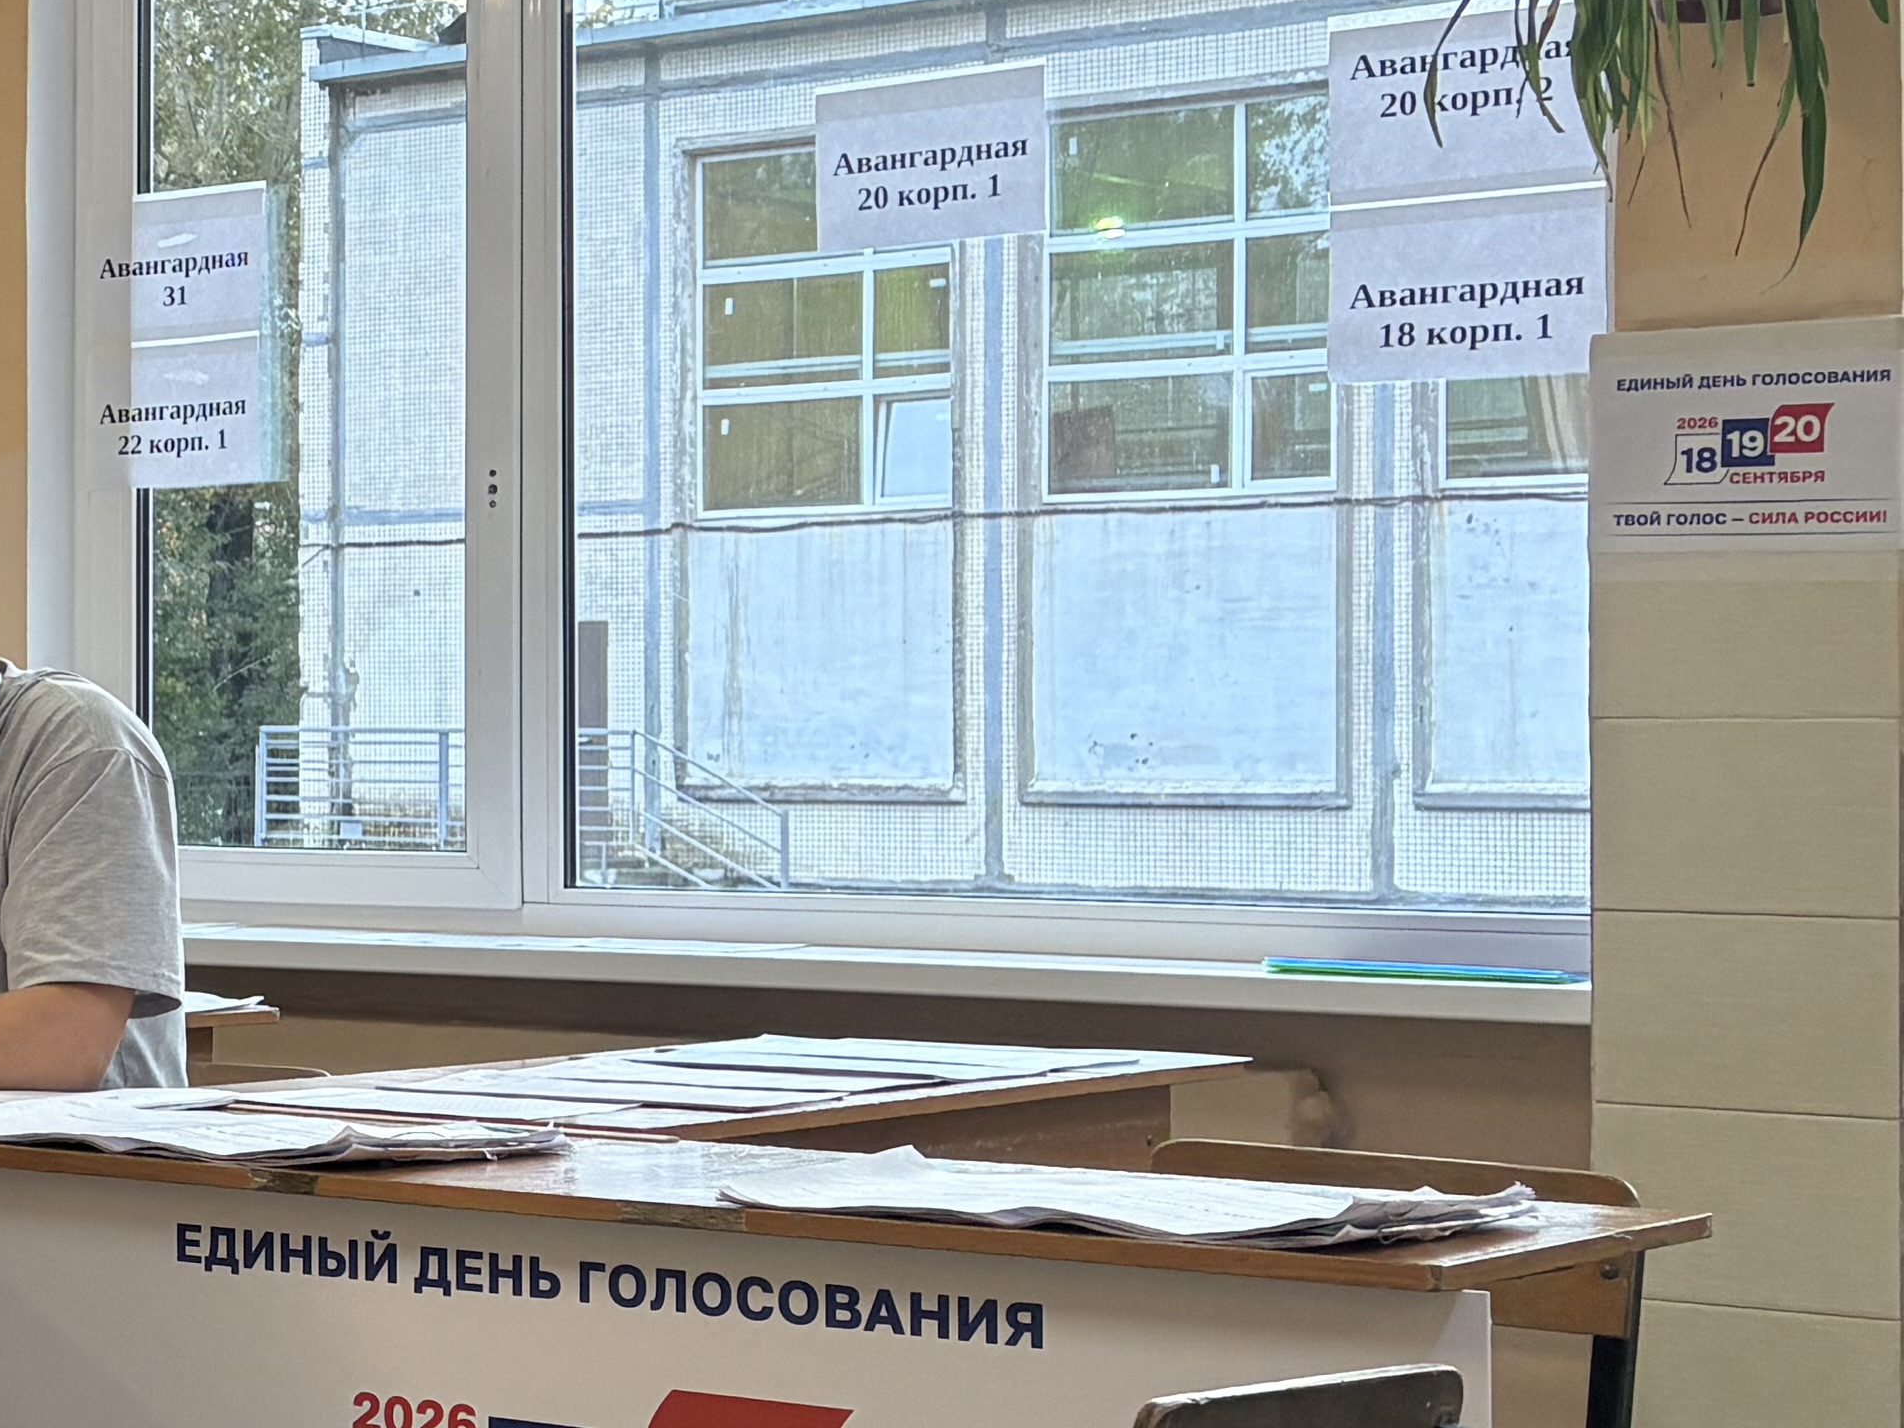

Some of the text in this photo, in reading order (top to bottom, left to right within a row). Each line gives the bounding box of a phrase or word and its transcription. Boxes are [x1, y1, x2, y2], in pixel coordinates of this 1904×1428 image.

[1350, 38, 1572, 81] Авангарда
[1380, 90, 1417, 118] 20
[1539, 77, 1553, 102] 2
[833, 138, 1028, 176] Авангардная
[858, 173, 1001, 211] 20 корп. 1
[100, 251, 249, 279] Авангардная
[162, 285, 188, 306] 31
[1349, 276, 1585, 310] Авангардная
[1379, 314, 1553, 350] 18 корп. 1
[1617, 369, 1891, 392] ЕДИНЫЙ ДЕНЬ ГОЛОСОВАНИЯ
[100, 399, 246, 425] Авангардная
[1676, 417, 1719, 430] 2026
[118, 429, 228, 458] 22 корп. 1
[1680, 414, 1821, 473] 18 19 20
[1729, 470, 1826, 485] СЕНТЯБРЯ
[1613, 511, 1662, 527] ТВОЙ
[1666, 512, 1727, 526] ГОЛОС
[1748, 511, 1798, 525] СИЛА
[1804, 510, 1887, 524] РОССИИ!
[176, 1223, 1044, 1349] ЕДИНЫЙ ДЕНЬ ГОЛОСОВАНИЯ
